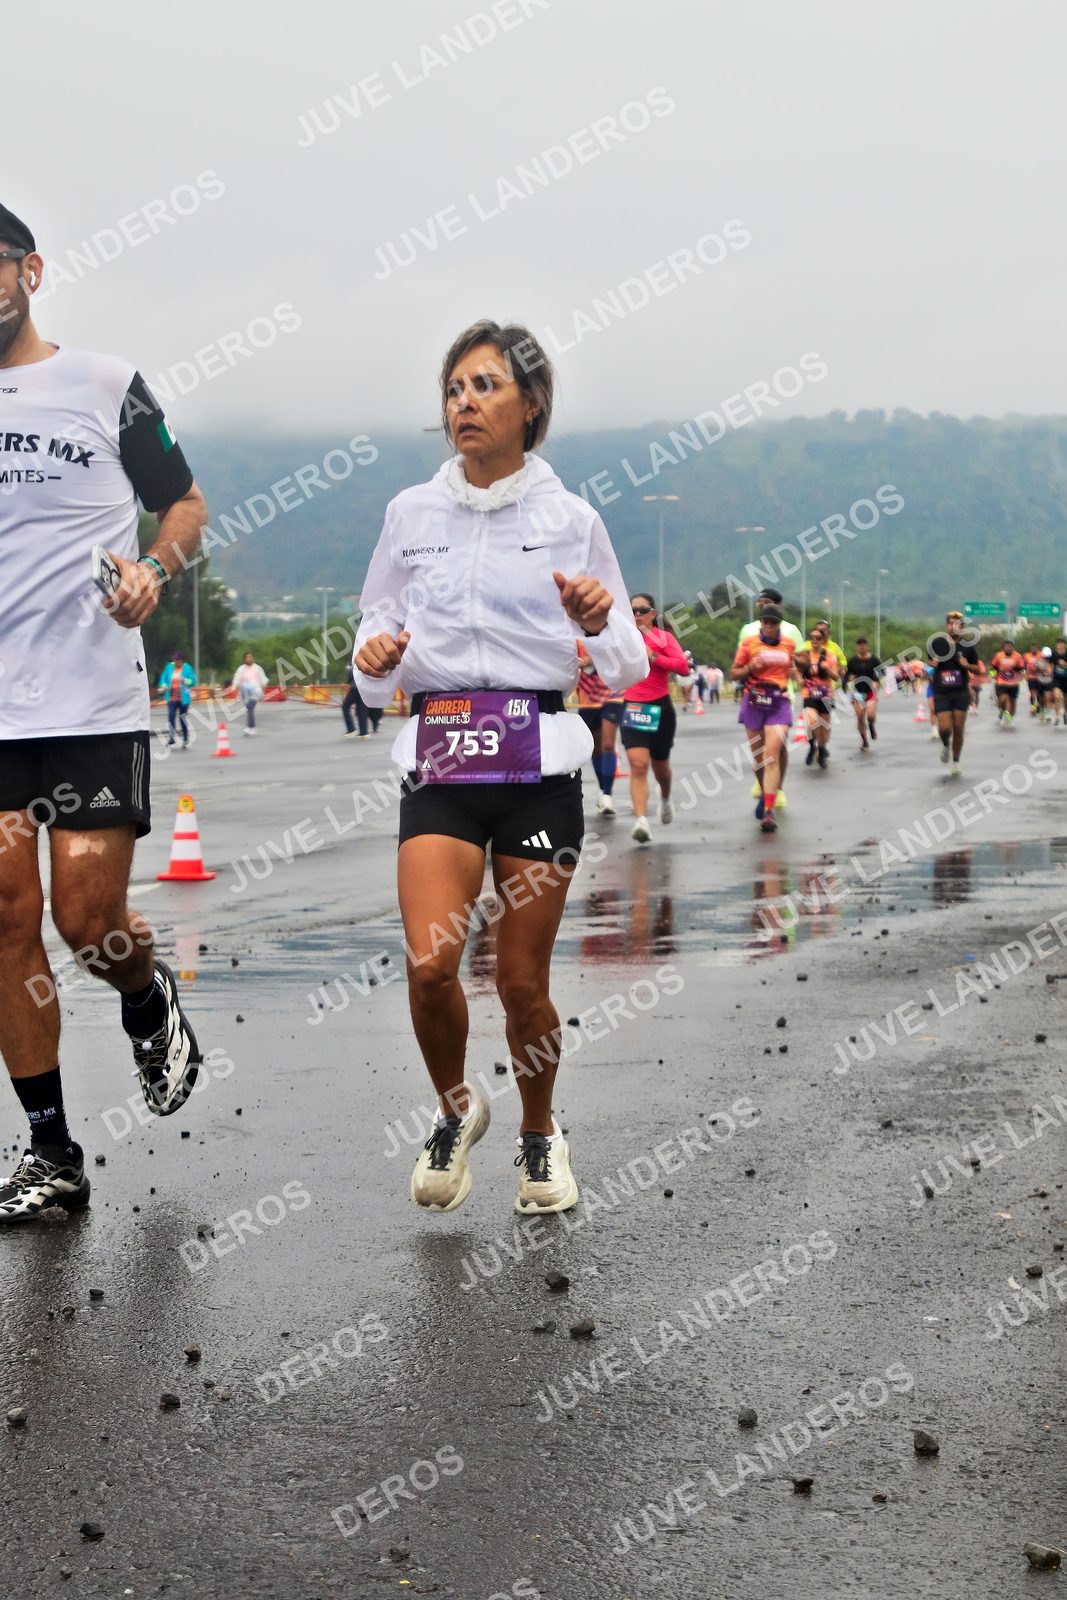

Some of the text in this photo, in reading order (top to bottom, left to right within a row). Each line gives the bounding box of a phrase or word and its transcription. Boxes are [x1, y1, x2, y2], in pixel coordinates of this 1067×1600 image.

[47, 438, 95, 468] MX
[425, 699, 472, 715] CARRERA
[507, 699, 530, 716] 15K
[630, 712, 652, 723] 1603
[445, 730, 499, 757] 753
[89, 799, 121, 808] adidas
[43, 1107, 57, 1117] MX
